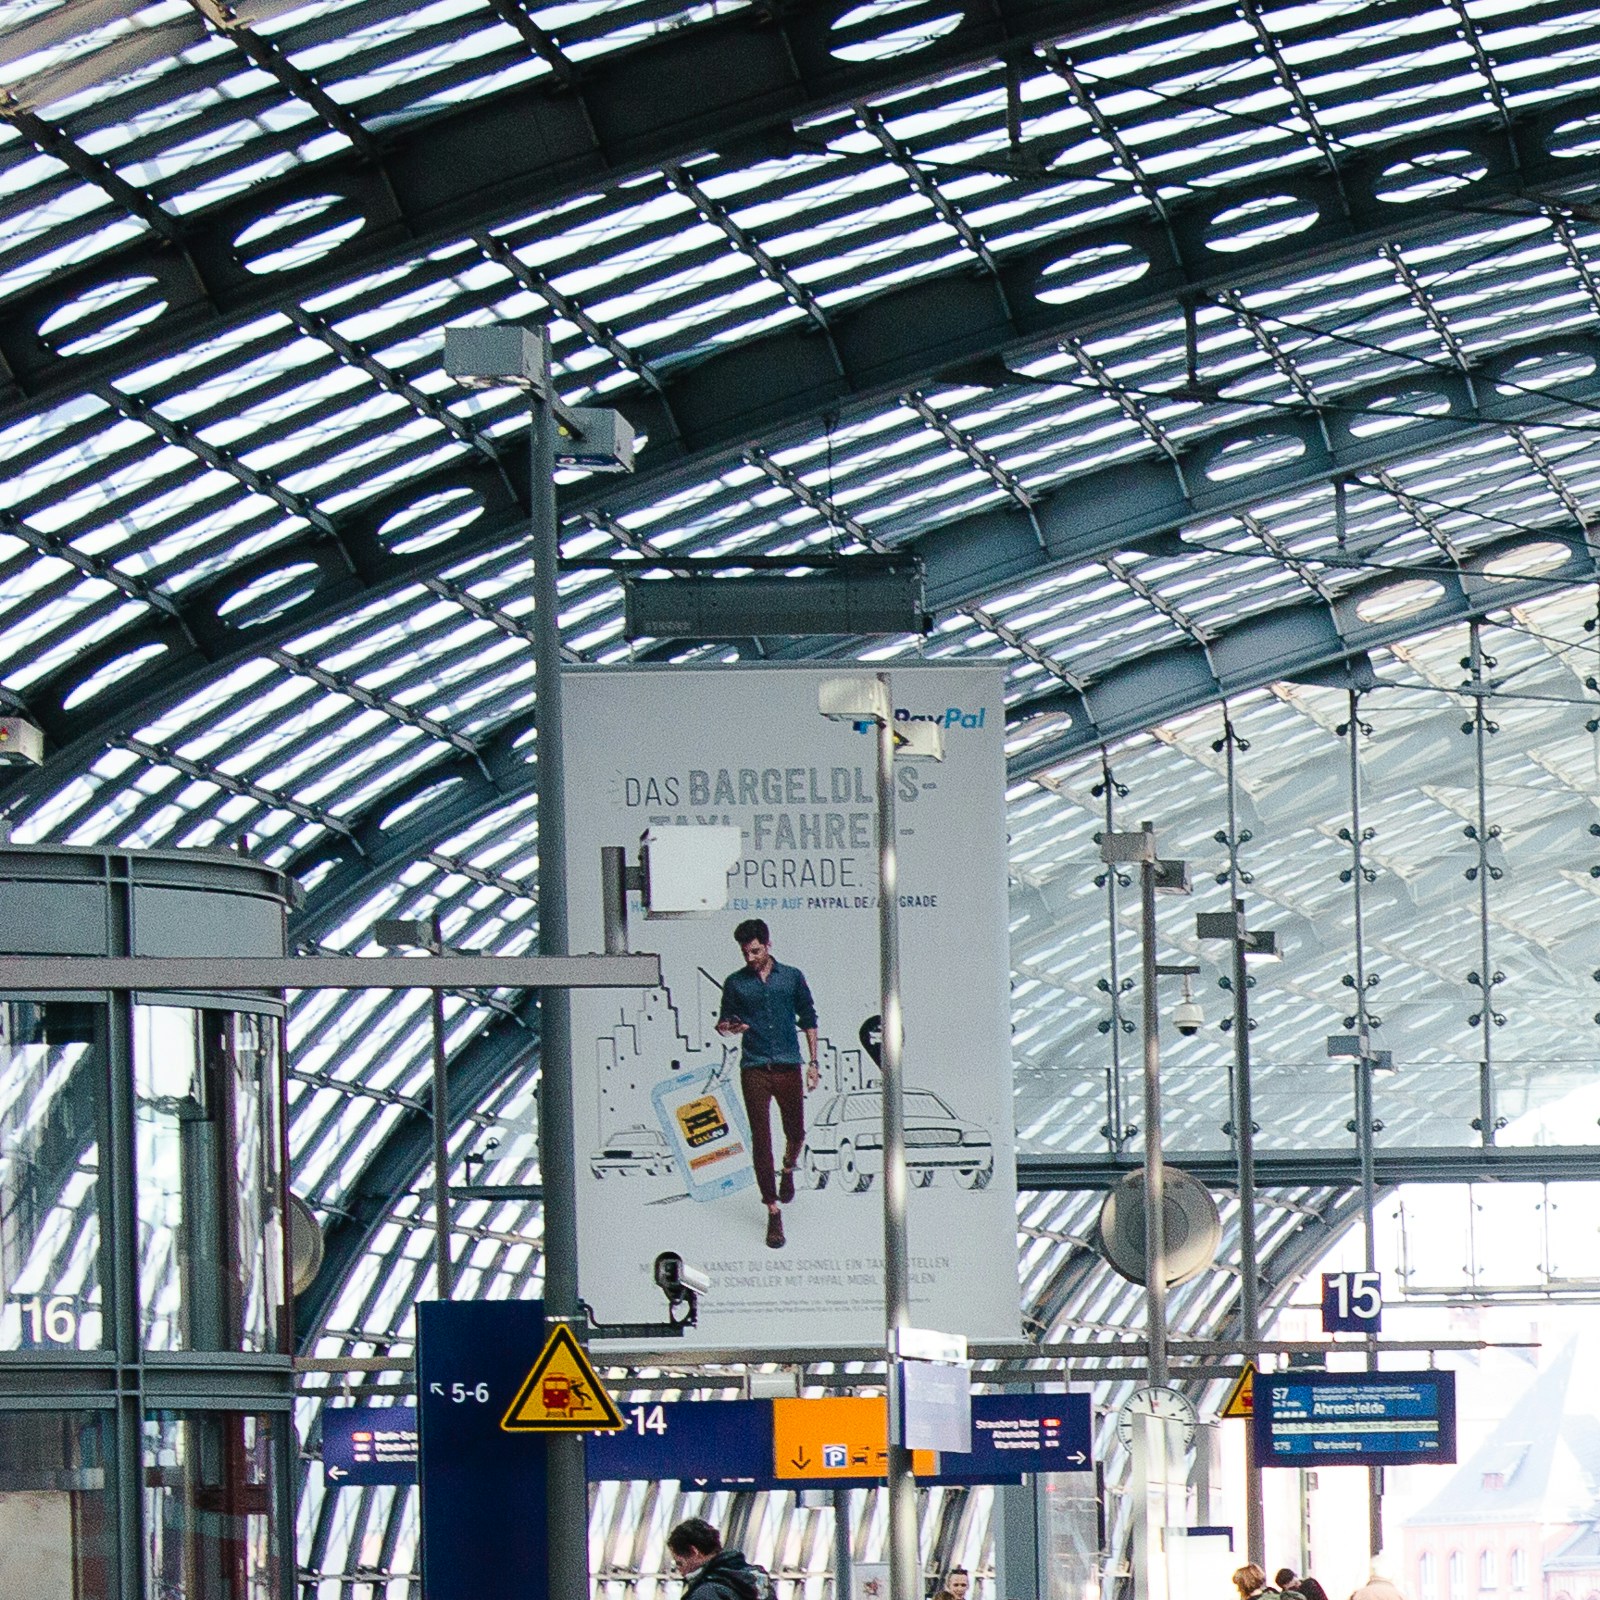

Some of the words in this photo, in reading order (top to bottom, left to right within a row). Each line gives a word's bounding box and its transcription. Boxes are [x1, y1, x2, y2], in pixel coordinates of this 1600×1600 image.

[625, 777, 680, 807] DAS
[688, 766, 938, 806] BARGELDLS-
[650, 812, 915, 851] -FAHRE-
[727, 857, 864, 889] PPGRADE.
[807, 895, 938, 910] PAYPAL.DE/GRADE
[1328, 1272, 1382, 1319] 15
[22, 1296, 76, 1343] 16
[452, 1382, 489, 1403] 5-6
[1272, 1387, 1289, 1400] S7
[595, 1405, 667, 1435] -14
[1313, 1403, 1386, 1415] Ahrensfelde
